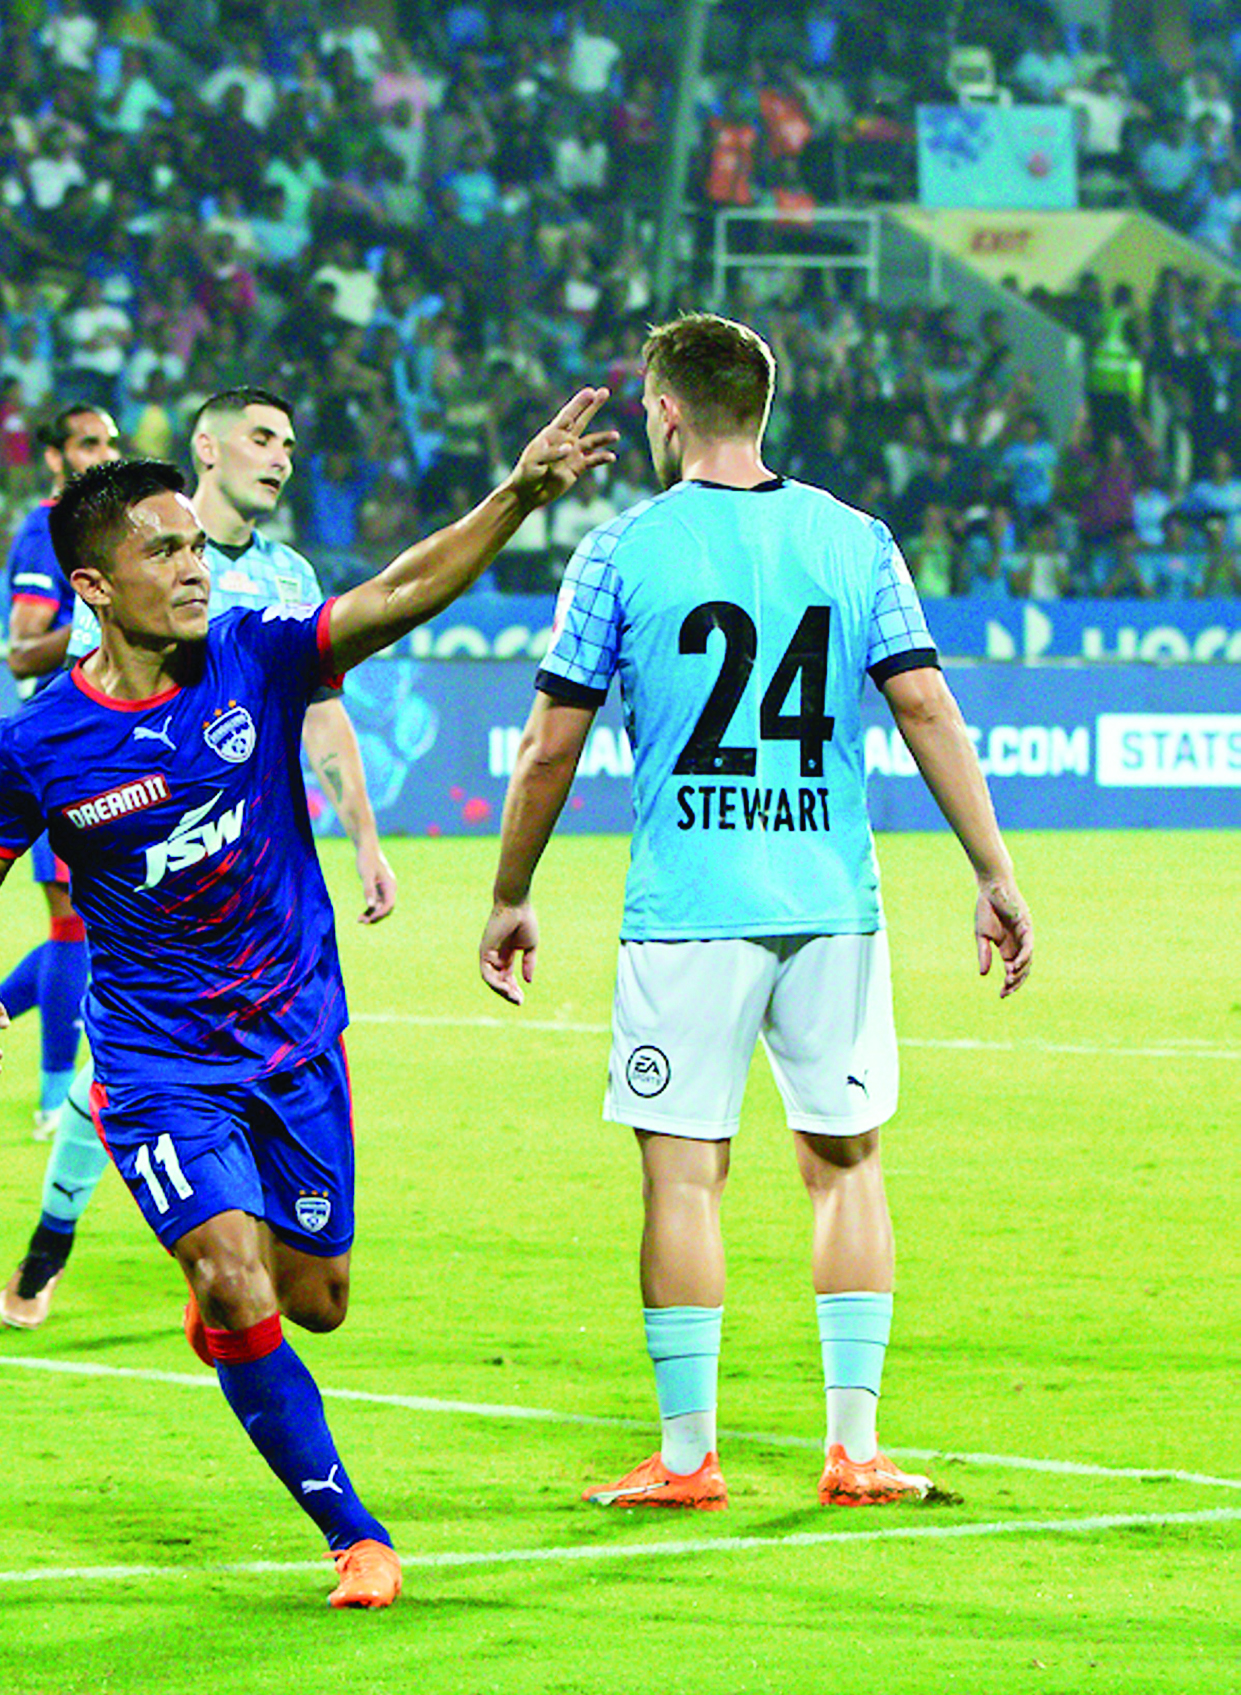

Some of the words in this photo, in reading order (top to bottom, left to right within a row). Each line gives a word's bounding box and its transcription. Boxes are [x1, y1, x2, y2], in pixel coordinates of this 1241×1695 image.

[671, 600, 835, 777] 24
[1121, 729, 1241, 770] STATS
[67, 776, 167, 829] DREAM11
[677, 785, 831, 832] STEWART
[133, 799, 245, 893] JSW
[634, 1055, 660, 1076] EA
[135, 1133, 194, 1214] 11
